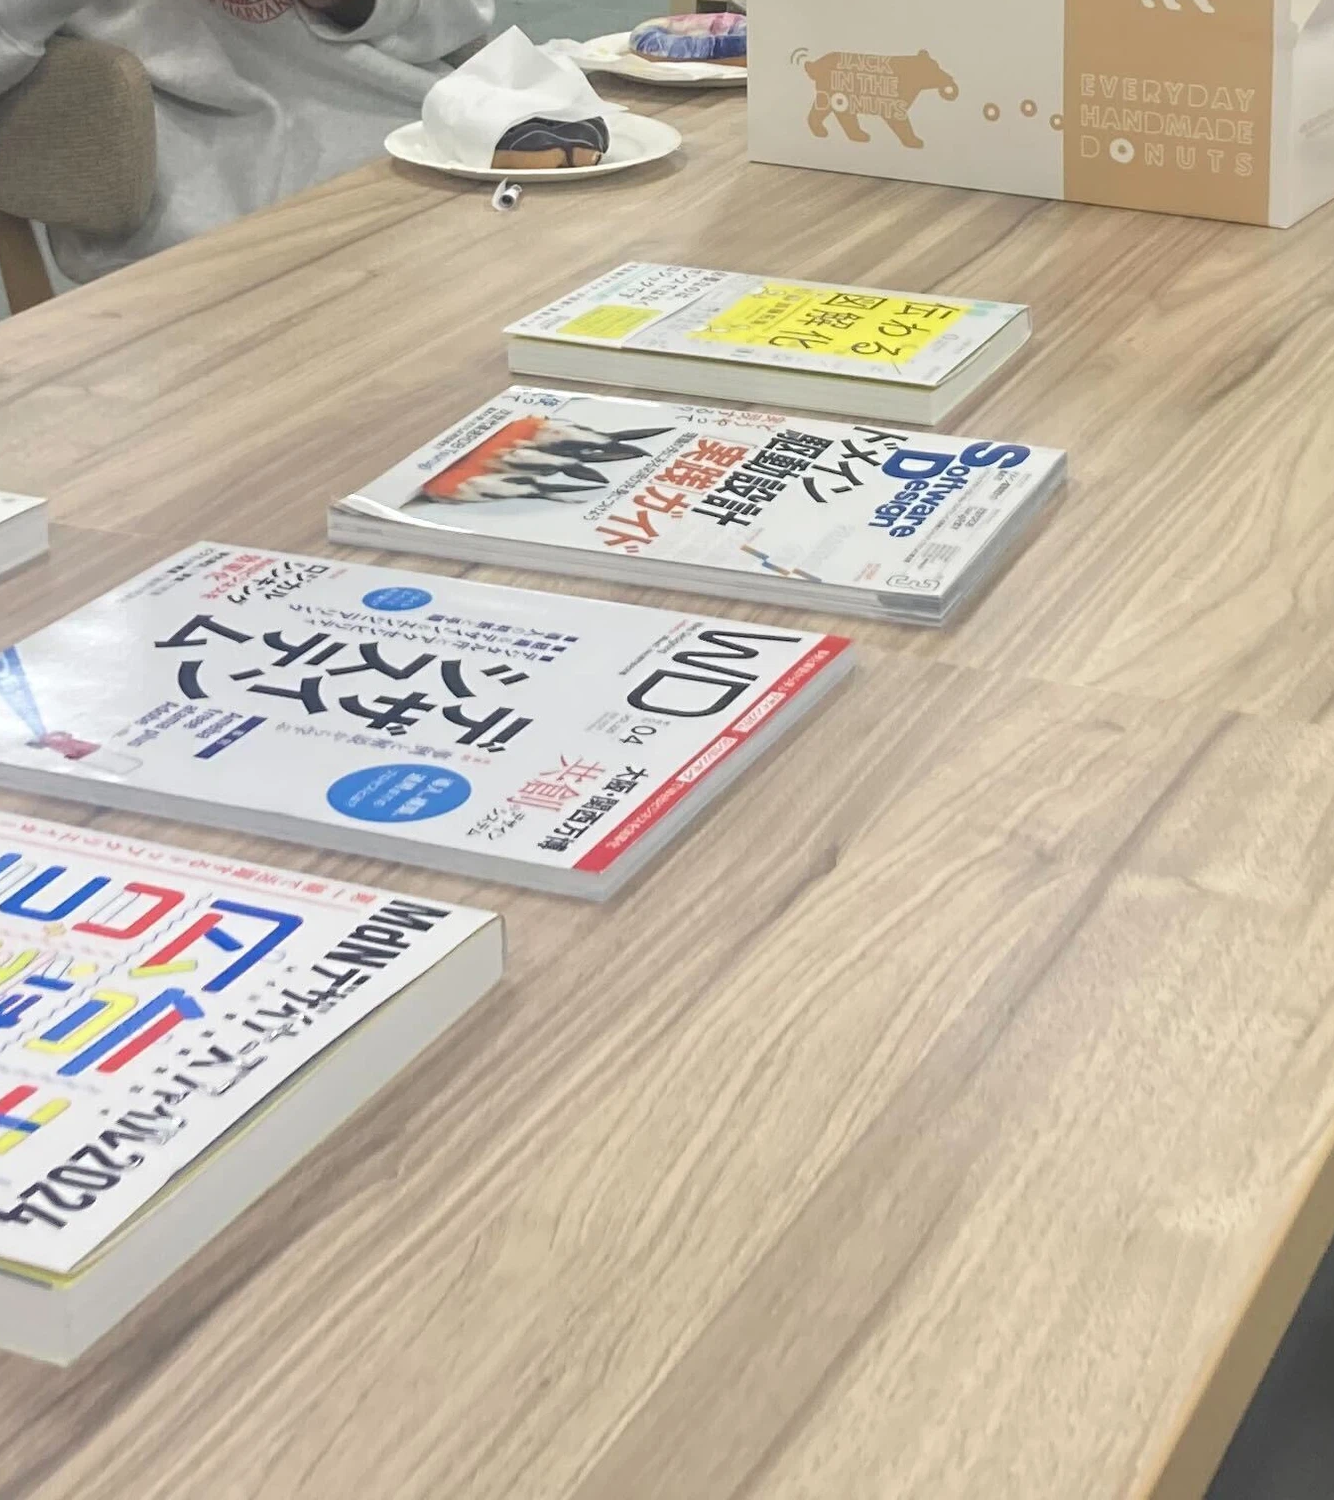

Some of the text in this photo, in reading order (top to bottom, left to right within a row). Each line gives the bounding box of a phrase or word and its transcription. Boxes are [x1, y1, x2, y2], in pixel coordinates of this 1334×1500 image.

[830, 69, 899, 98] IN THE
[837, 52, 894, 75] JACK
[814, 88, 909, 121] DONUTS
[1080, 73, 1255, 113] EVERYDAY
[1080, 103, 1255, 145] HANDMADE
[1080, 135, 1255, 177] DONUTS
[757, 292, 893, 350] 図解化
[838, 301, 963, 358] 伝わる
[673, 429, 847, 528] 駆動設計
[775, 426, 915, 505] ドメイン
[824, 448, 962, 528] Design
[883, 442, 1031, 539] Software
[219, 560, 305, 605] シンキング
[259, 564, 330, 601] ロジカル
[149, 614, 530, 700] システム
[613, 624, 802, 721] WD
[174, 659, 541, 754] デザイン
[613, 724, 659, 746] 04
[532, 765, 653, 853] 大阪・関西万博
